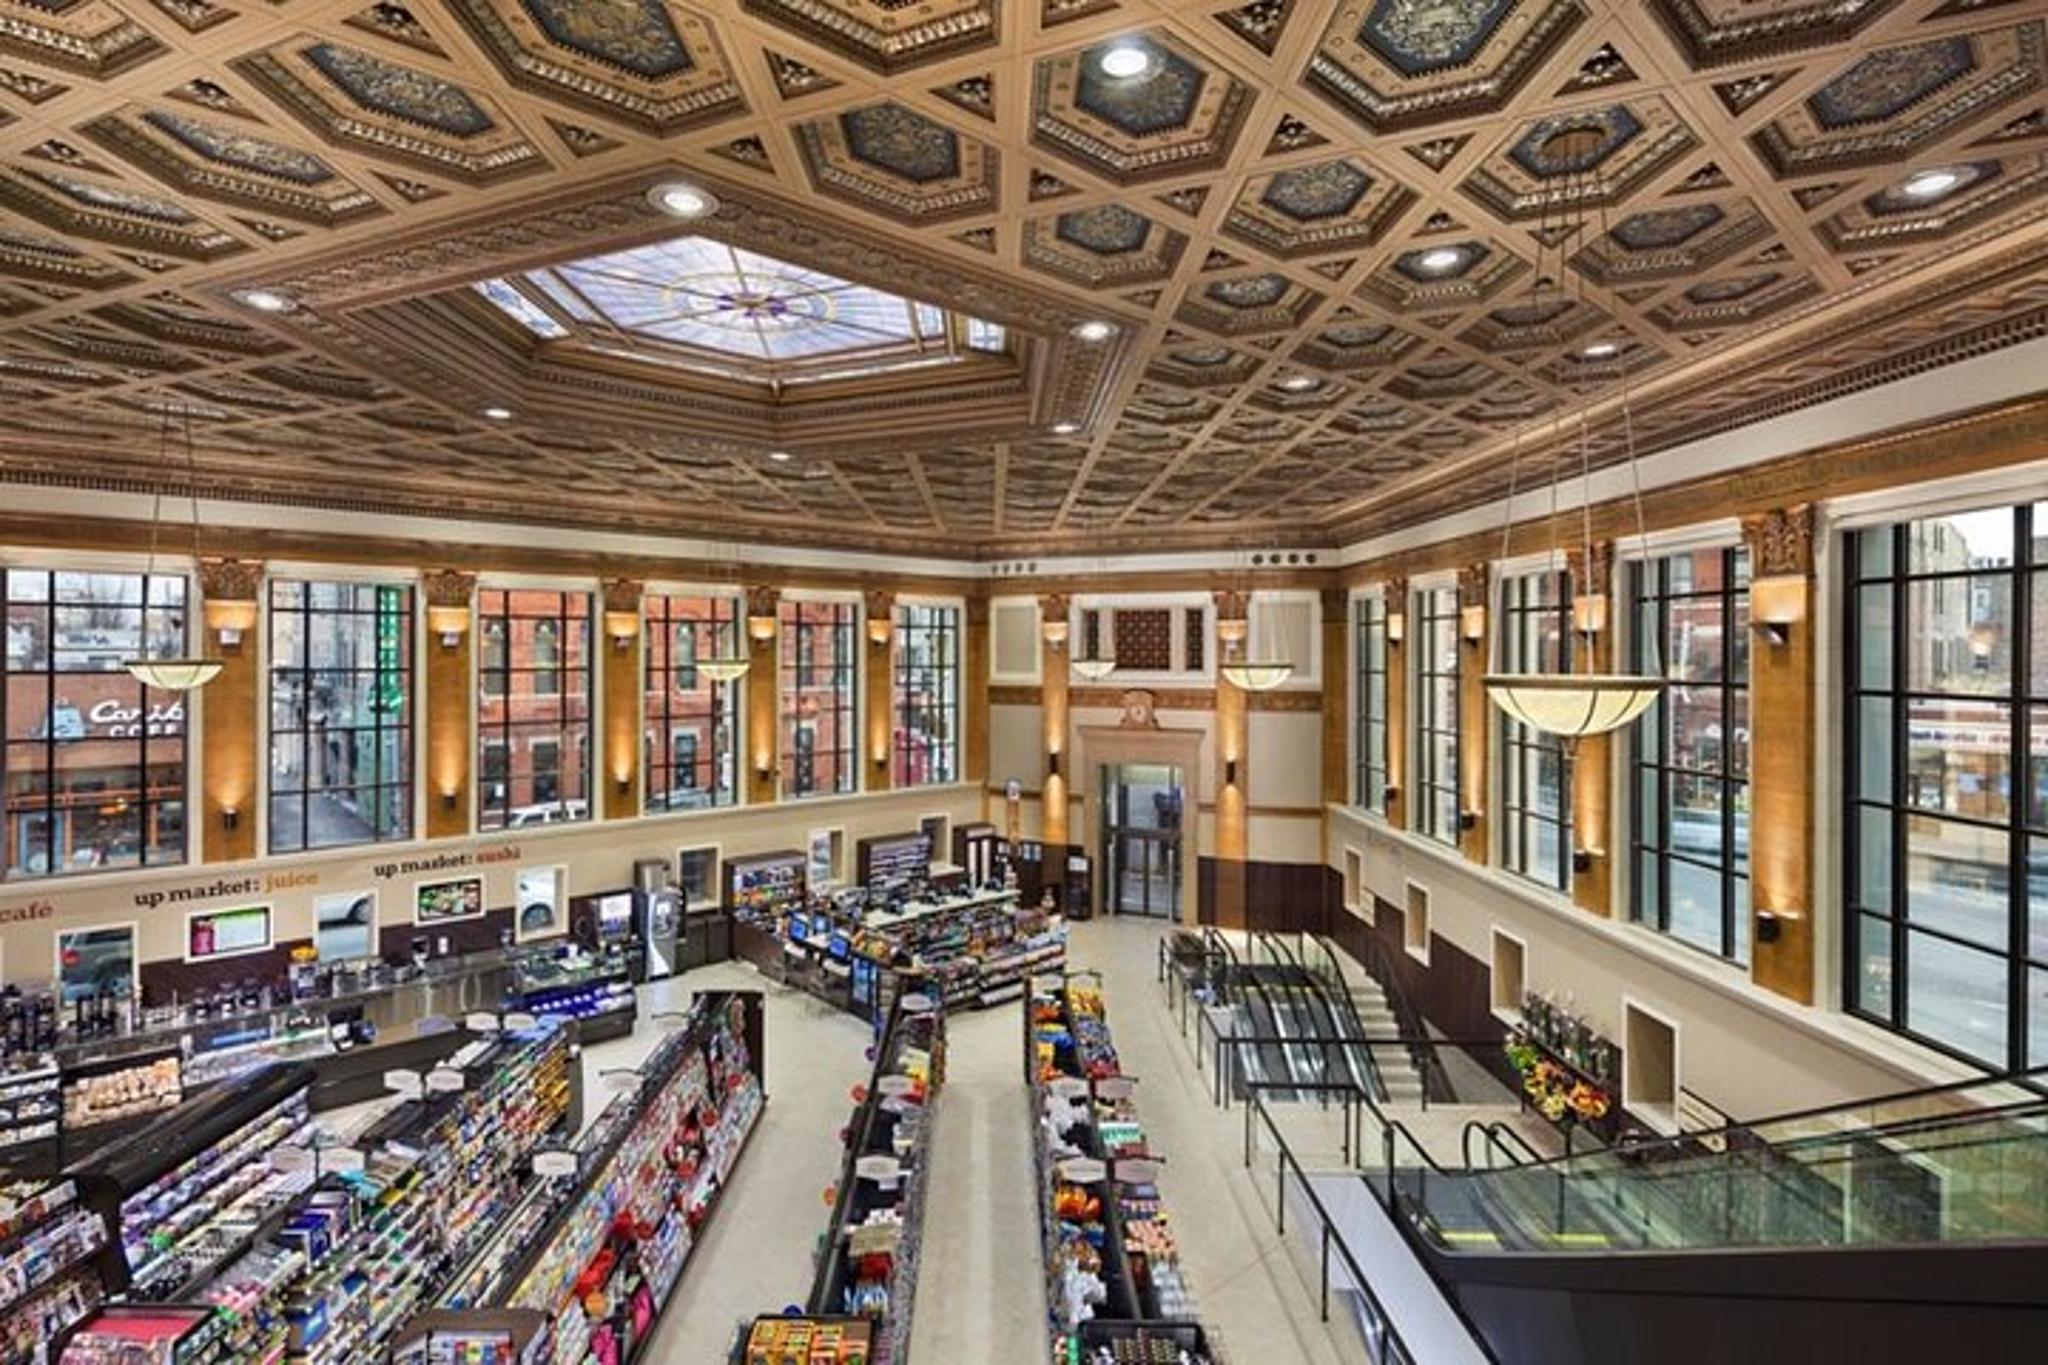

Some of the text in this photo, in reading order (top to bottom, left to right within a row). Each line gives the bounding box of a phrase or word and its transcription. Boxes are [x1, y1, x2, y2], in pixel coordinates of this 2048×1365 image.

[373, 864, 399, 878] up
[400, 854, 473, 873] market:
[134, 868, 320, 908] up market: juice
[0, 899, 53, 924] café
